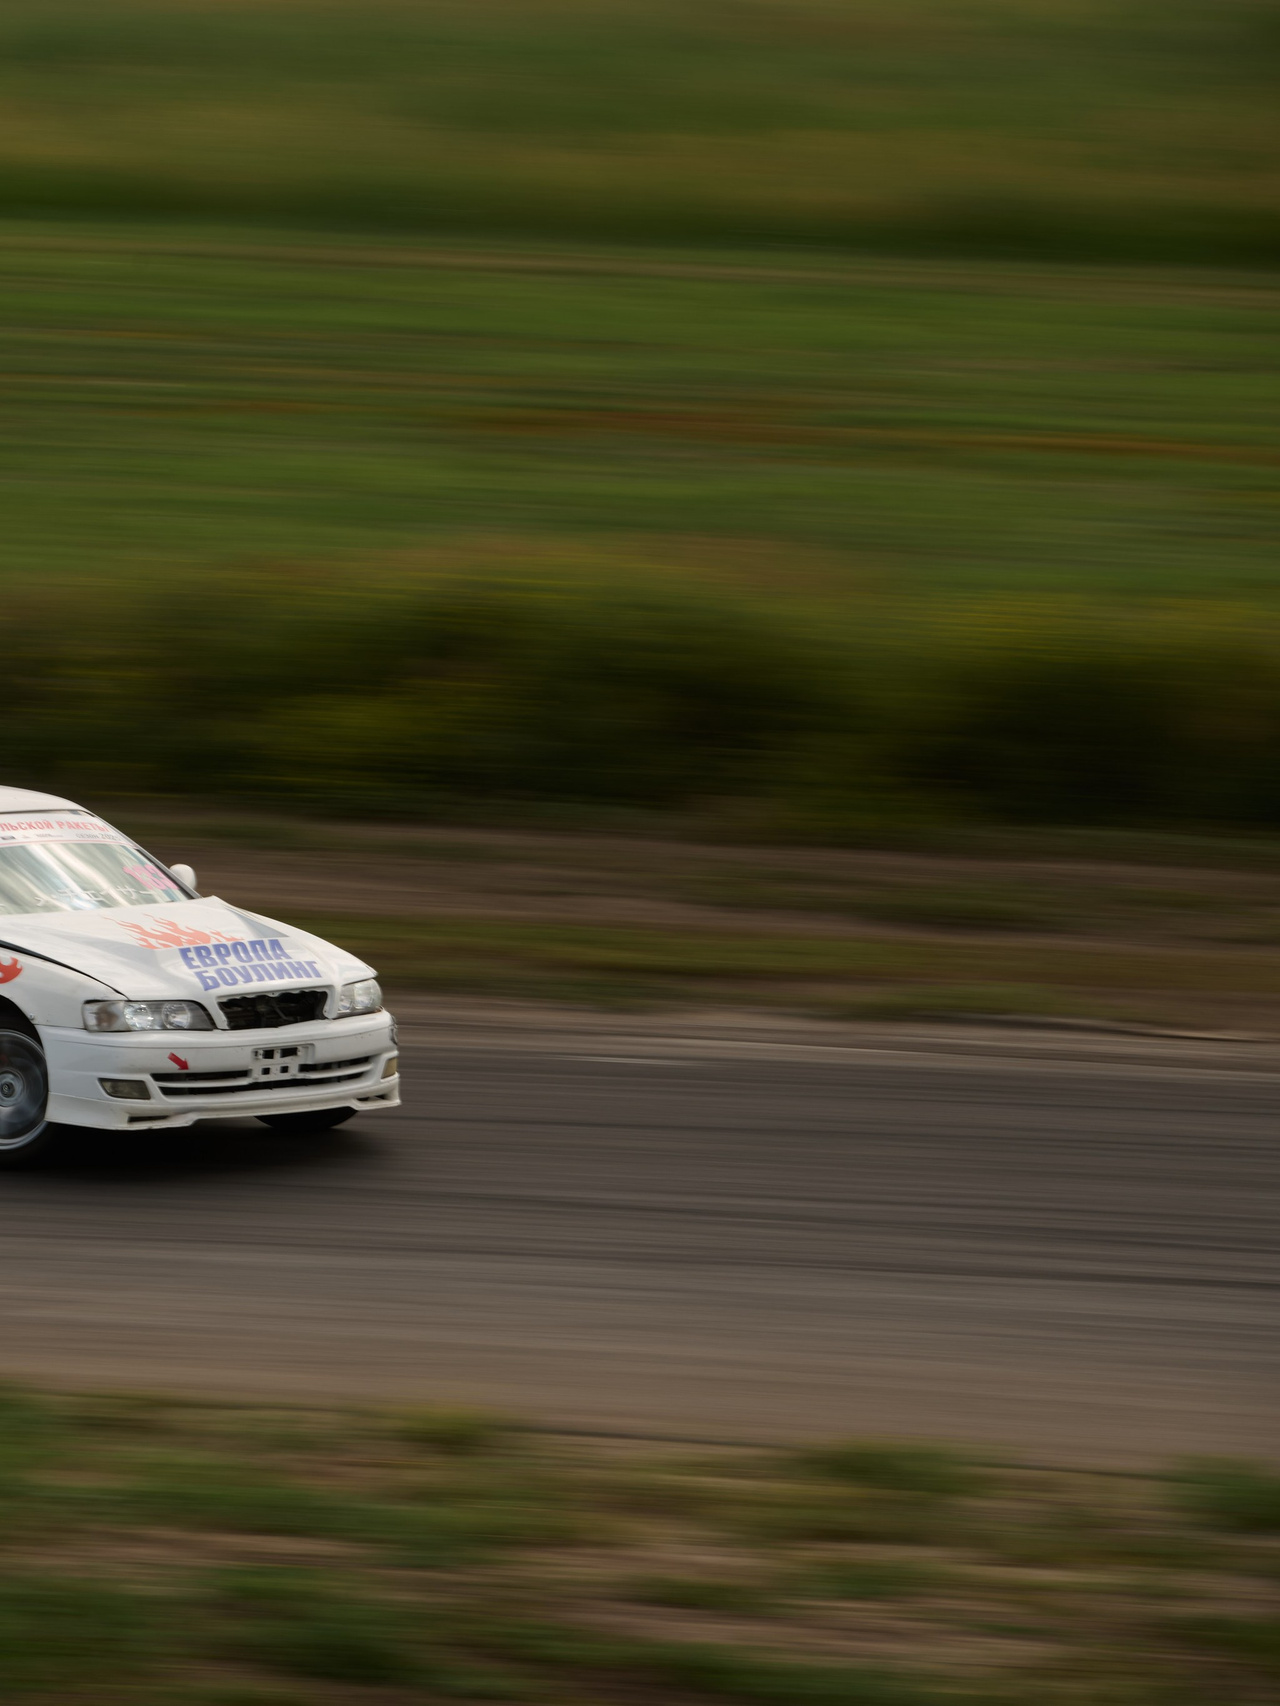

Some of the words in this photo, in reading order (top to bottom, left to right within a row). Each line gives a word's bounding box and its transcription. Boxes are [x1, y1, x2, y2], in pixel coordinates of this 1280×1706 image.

[55, 820, 110, 832] РАКЕТЫ
[178, 938, 292, 970] ЕВРОПА
[193, 960, 324, 992] БОУЛИНГ
